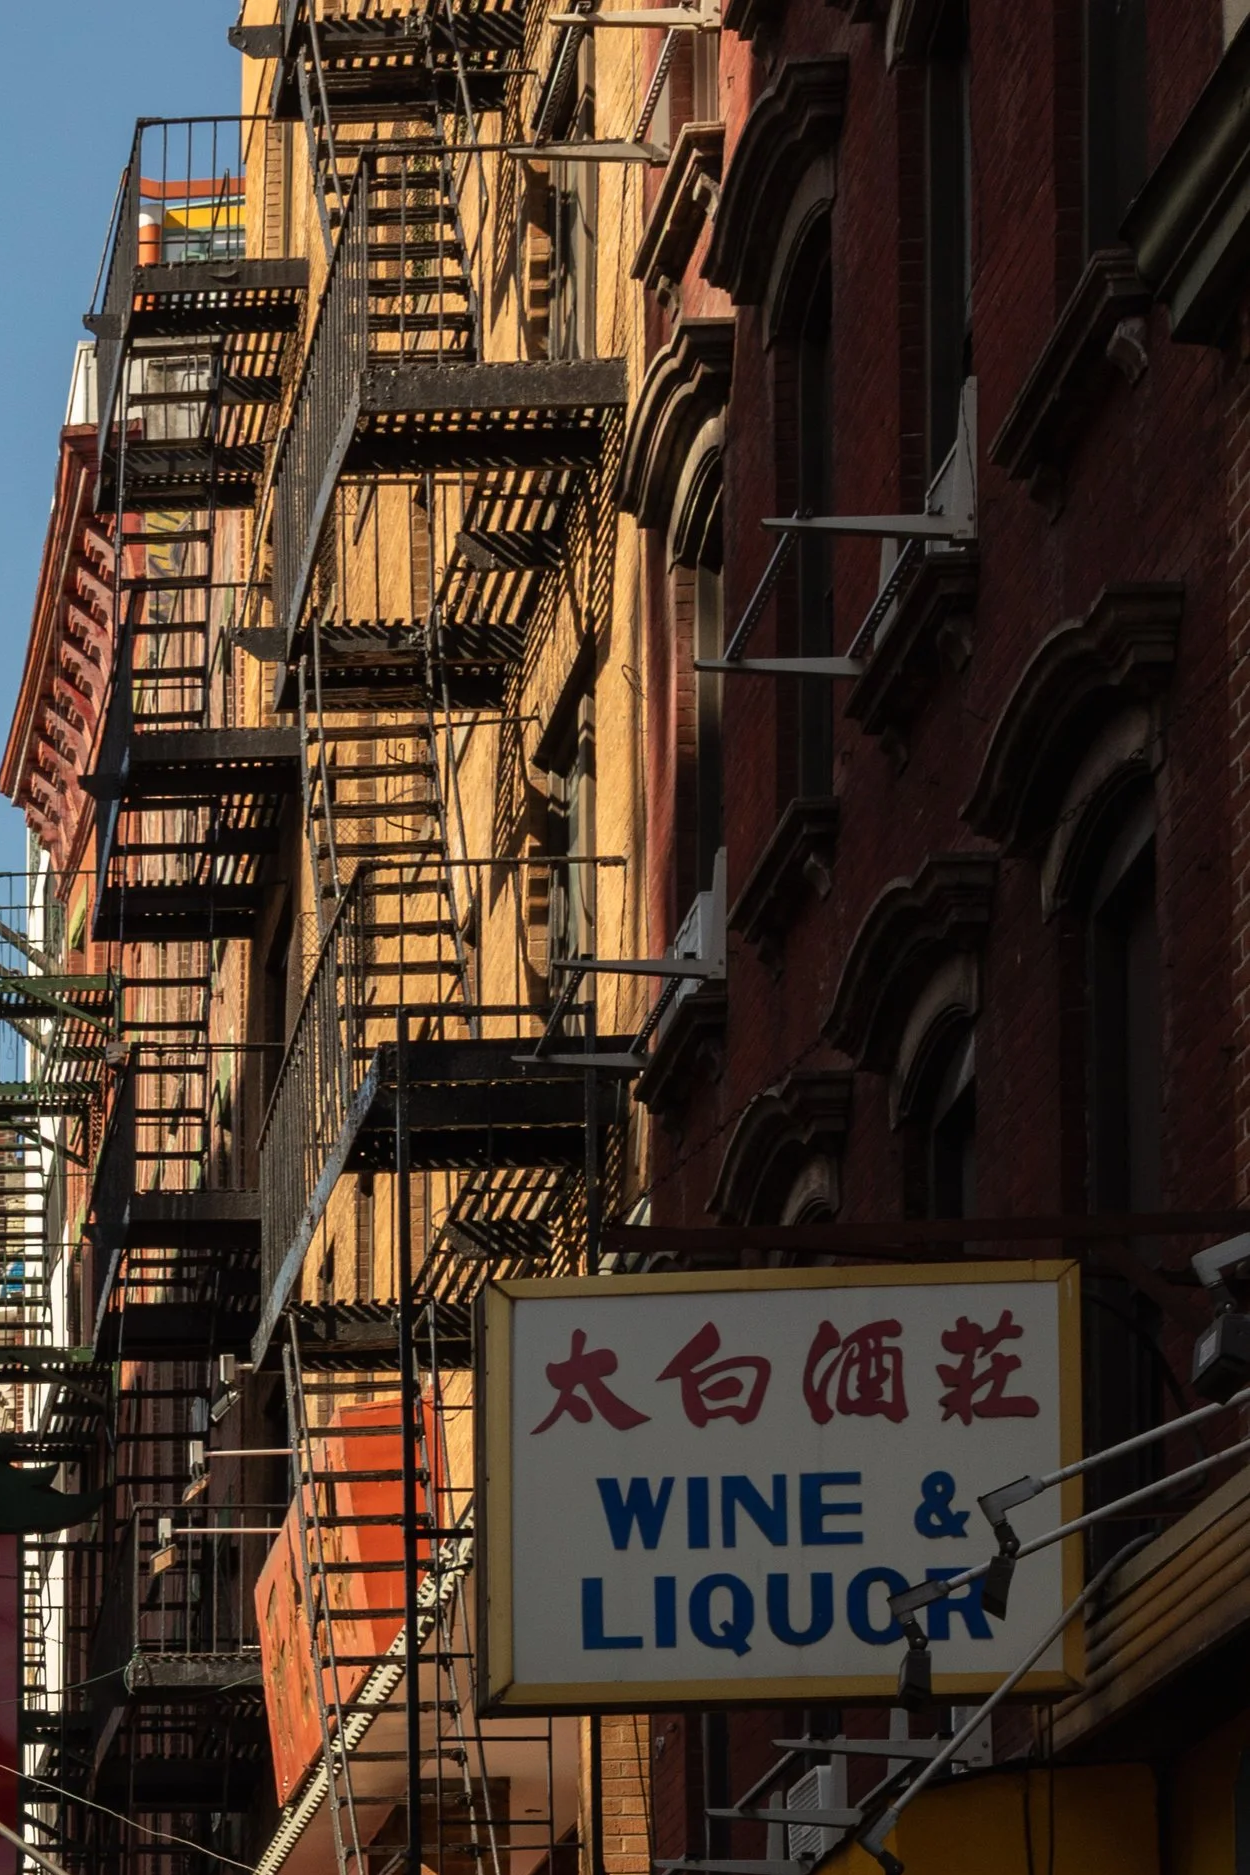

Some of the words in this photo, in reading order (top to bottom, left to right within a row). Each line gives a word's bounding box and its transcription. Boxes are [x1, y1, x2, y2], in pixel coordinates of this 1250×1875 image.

[596, 1472, 863, 1550] WINE
[914, 1470, 970, 1539] &
[582, 1566, 994, 1656] LIQUOR
